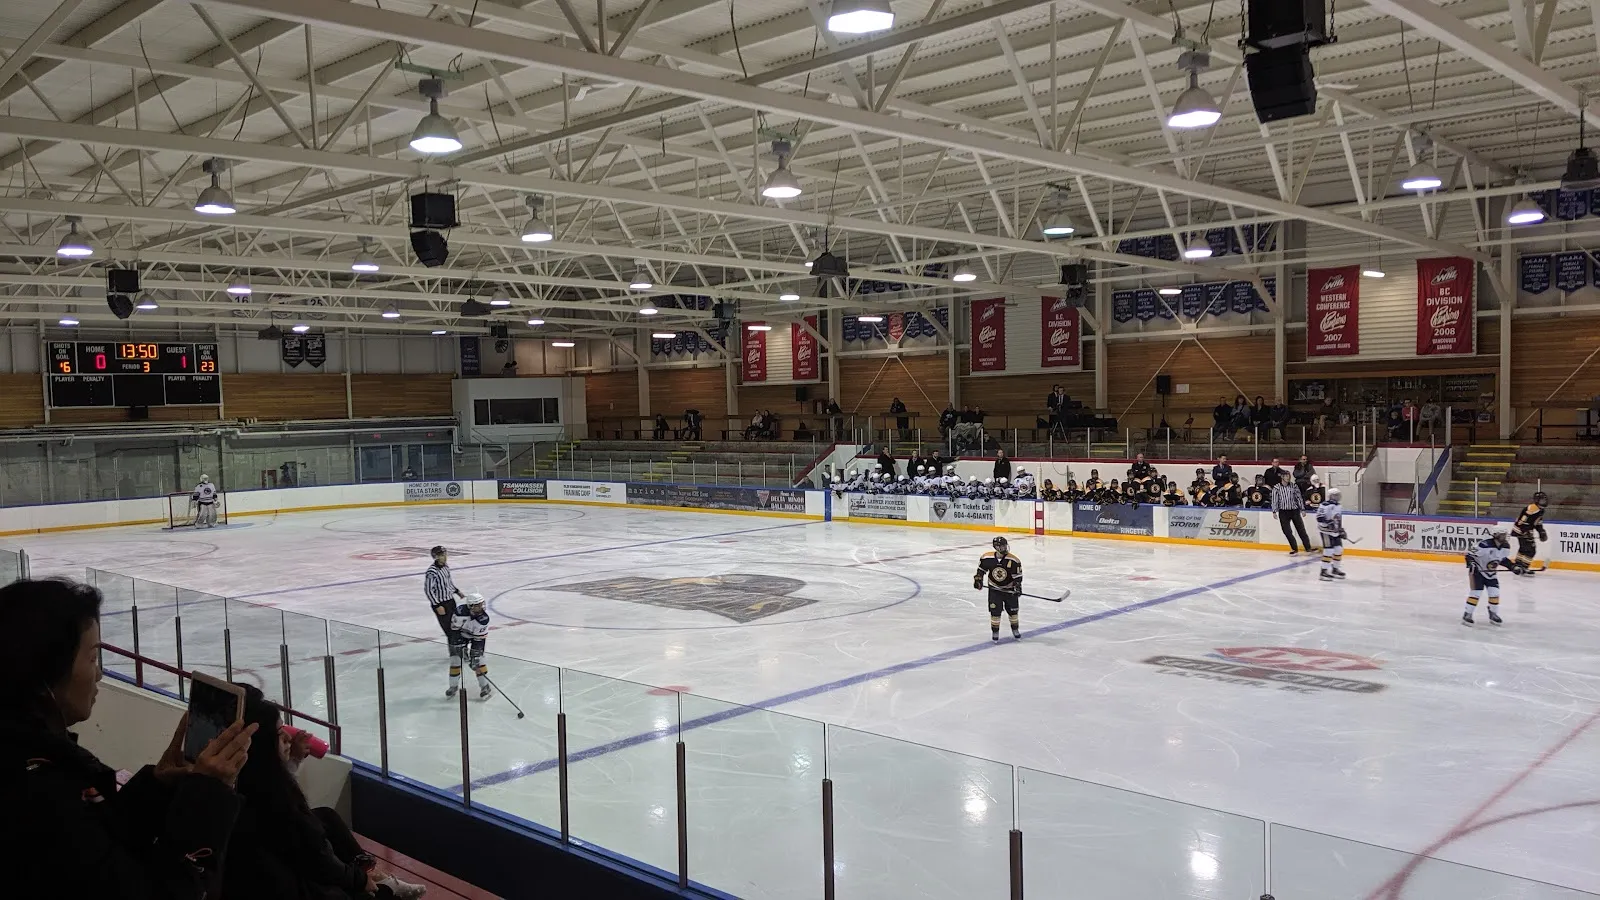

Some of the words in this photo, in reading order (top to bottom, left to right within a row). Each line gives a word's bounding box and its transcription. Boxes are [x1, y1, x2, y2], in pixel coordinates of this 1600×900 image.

[1440, 288, 1450, 296] BC
[1320, 293, 1346, 302] WESTERN
[1426, 296, 1462, 306] DIVISION
[1316, 302, 1350, 311] CONFERENCE
[122, 344, 157, 358] 13:50
[96, 355, 106, 369] 0
[143, 362, 150, 372] 3
[181, 356, 186, 368] 1
[201, 362, 214, 372] 23
[954, 512, 993, 520] 604-4-GIANTS
[1210, 528, 1256, 537] STORM
[1388, 523, 1416, 533] ISLANDERS
[1446, 526, 1490, 536] DELTA
[1421, 536, 1483, 551] ISLANDE
